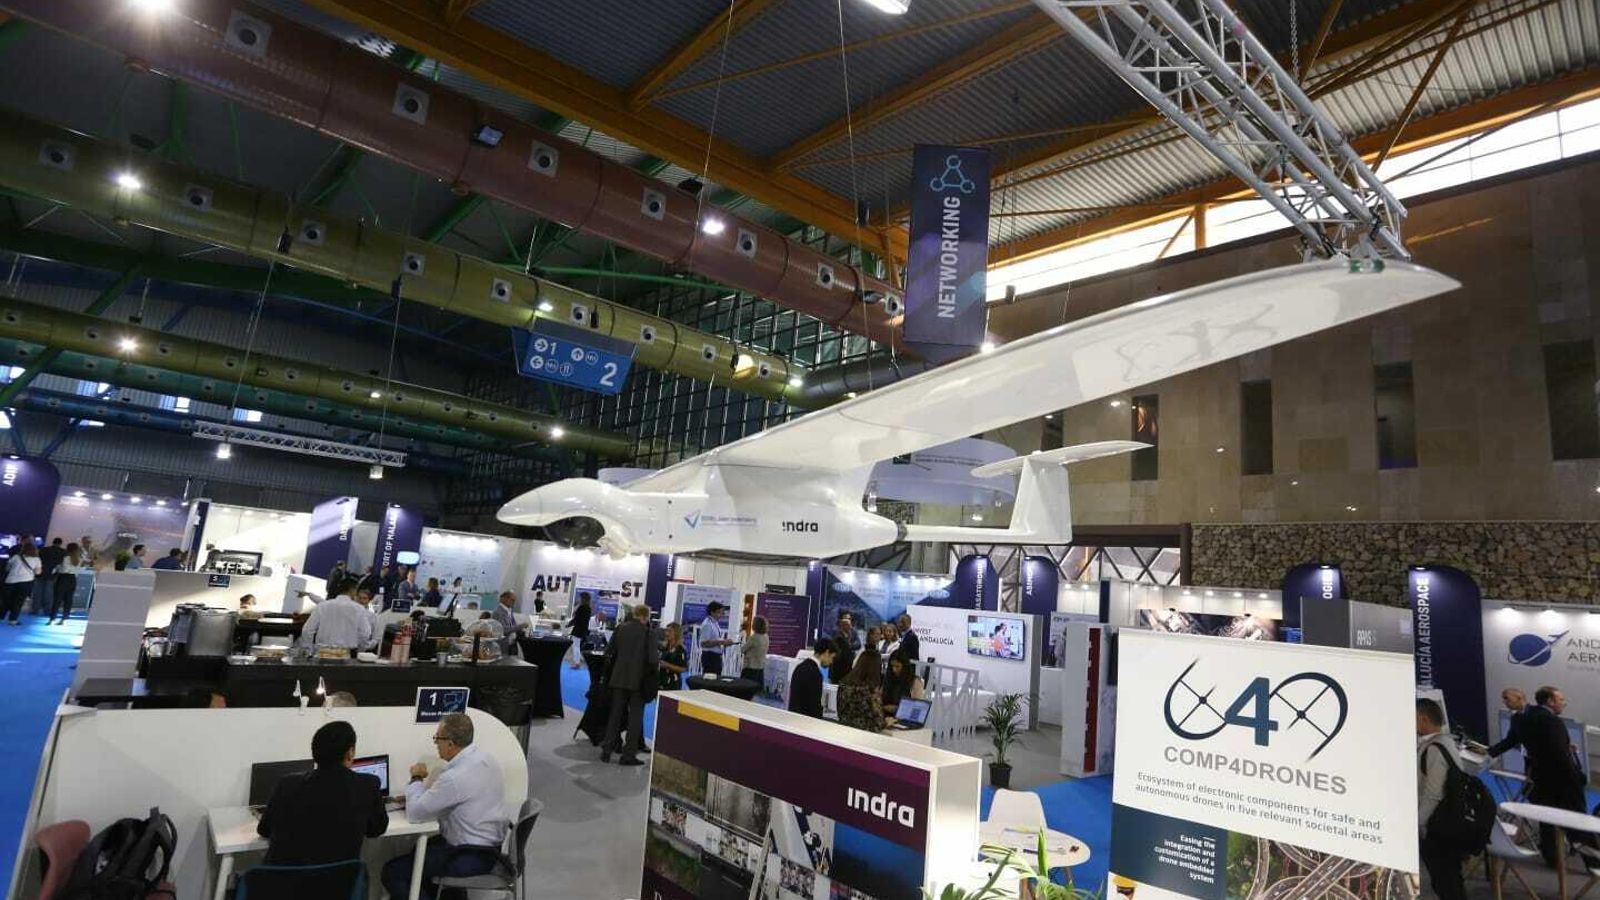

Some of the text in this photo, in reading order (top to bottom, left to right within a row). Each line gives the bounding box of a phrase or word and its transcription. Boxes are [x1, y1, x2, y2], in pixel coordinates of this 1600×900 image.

[937, 196, 961, 319] NETWORKING
[550, 342, 557, 356] 1
[600, 362, 618, 387] 2
[1416, 578, 1432, 690] ALUCÍA AEROSPACE
[1568, 651, 1600, 664] AER
[430, 692, 437, 706] 1
[1164, 746, 1347, 795] COMP4DRONES
[1138, 771, 1381, 830] Ecosystem of electronic components for safe and
[1136, 783, 1383, 844] autonomous drones in five relevant societal areas
[1164, 840, 1215, 858] integration and
[1180, 834, 1215, 850] Easing the
[1154, 846, 1201, 862] customization
[1158, 856, 1215, 876] drone embedded
[1189, 872, 1215, 884] system
